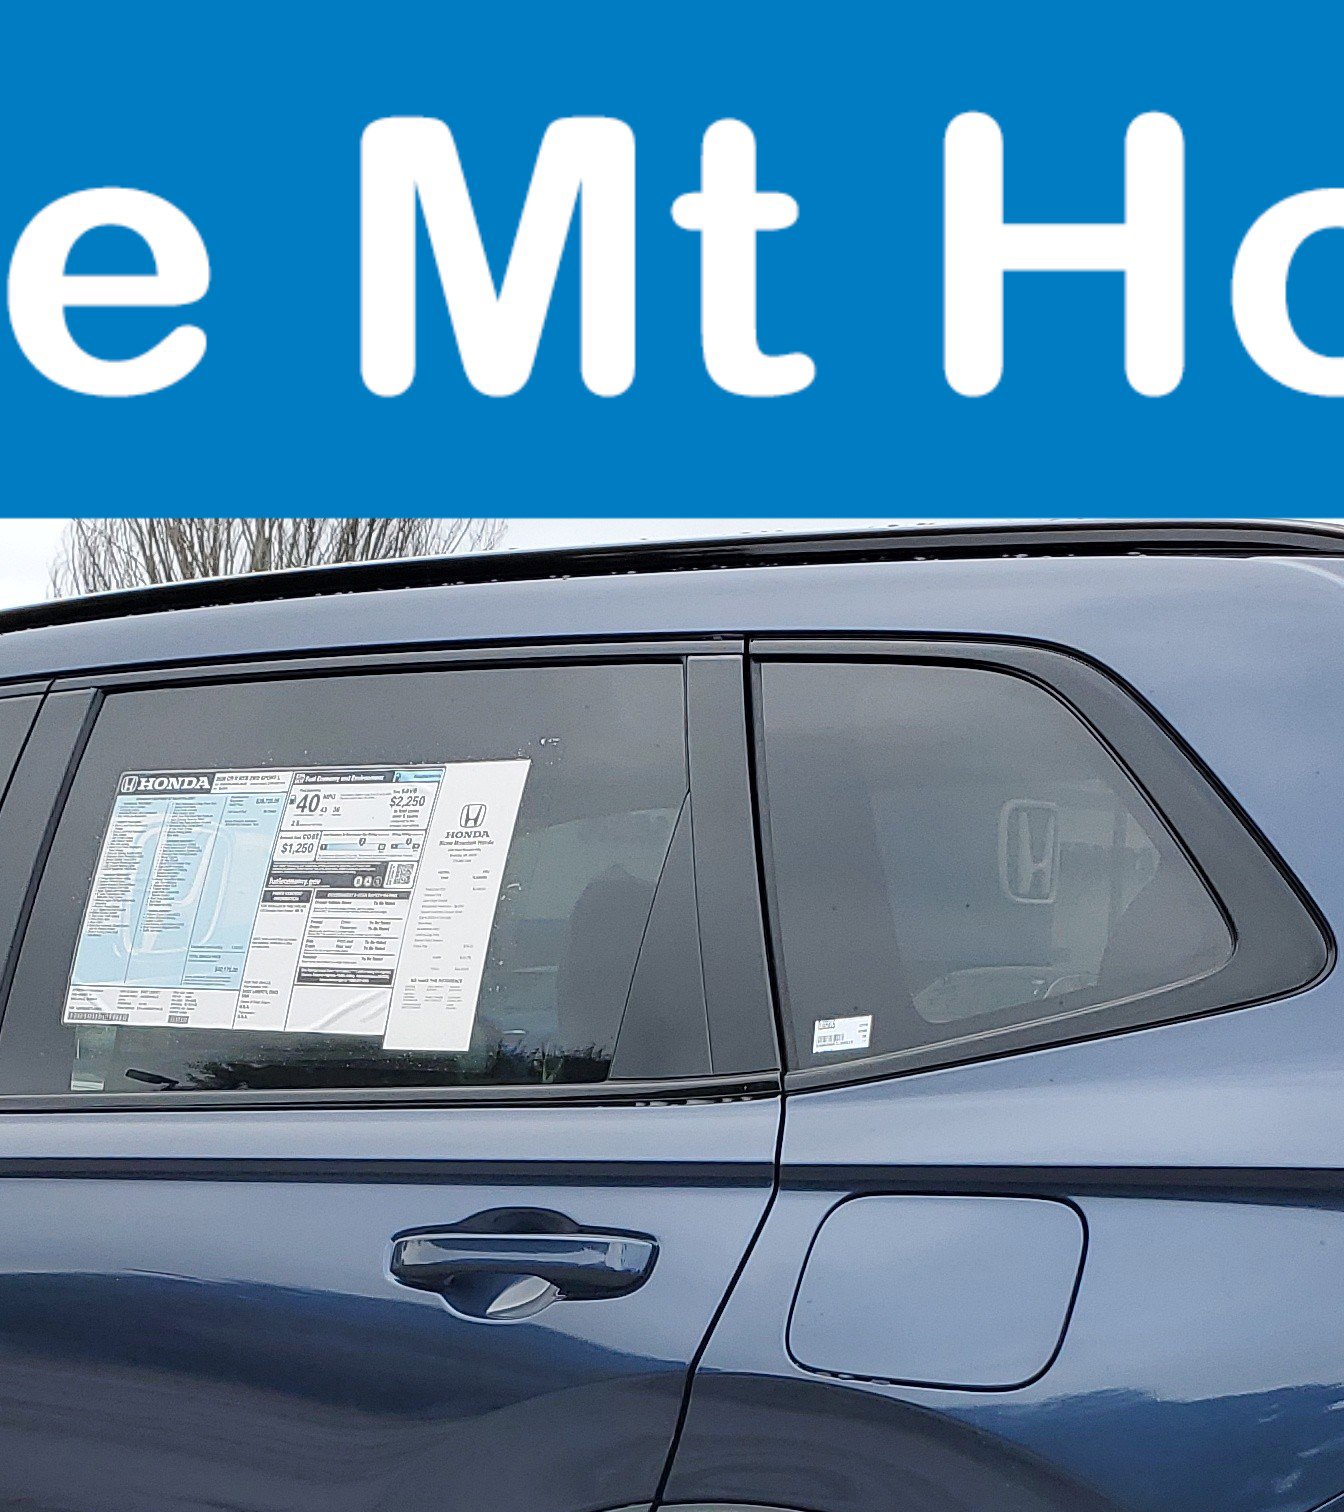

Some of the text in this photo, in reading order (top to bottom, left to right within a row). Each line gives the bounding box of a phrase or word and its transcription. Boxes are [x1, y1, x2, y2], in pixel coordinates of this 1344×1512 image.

[137, 776, 211, 791] HONDA
[296, 793, 321, 813] 40
[389, 795, 426, 808] $2,250
[445, 830, 490, 839] HONDA
[281, 842, 314, 854] $1,250
